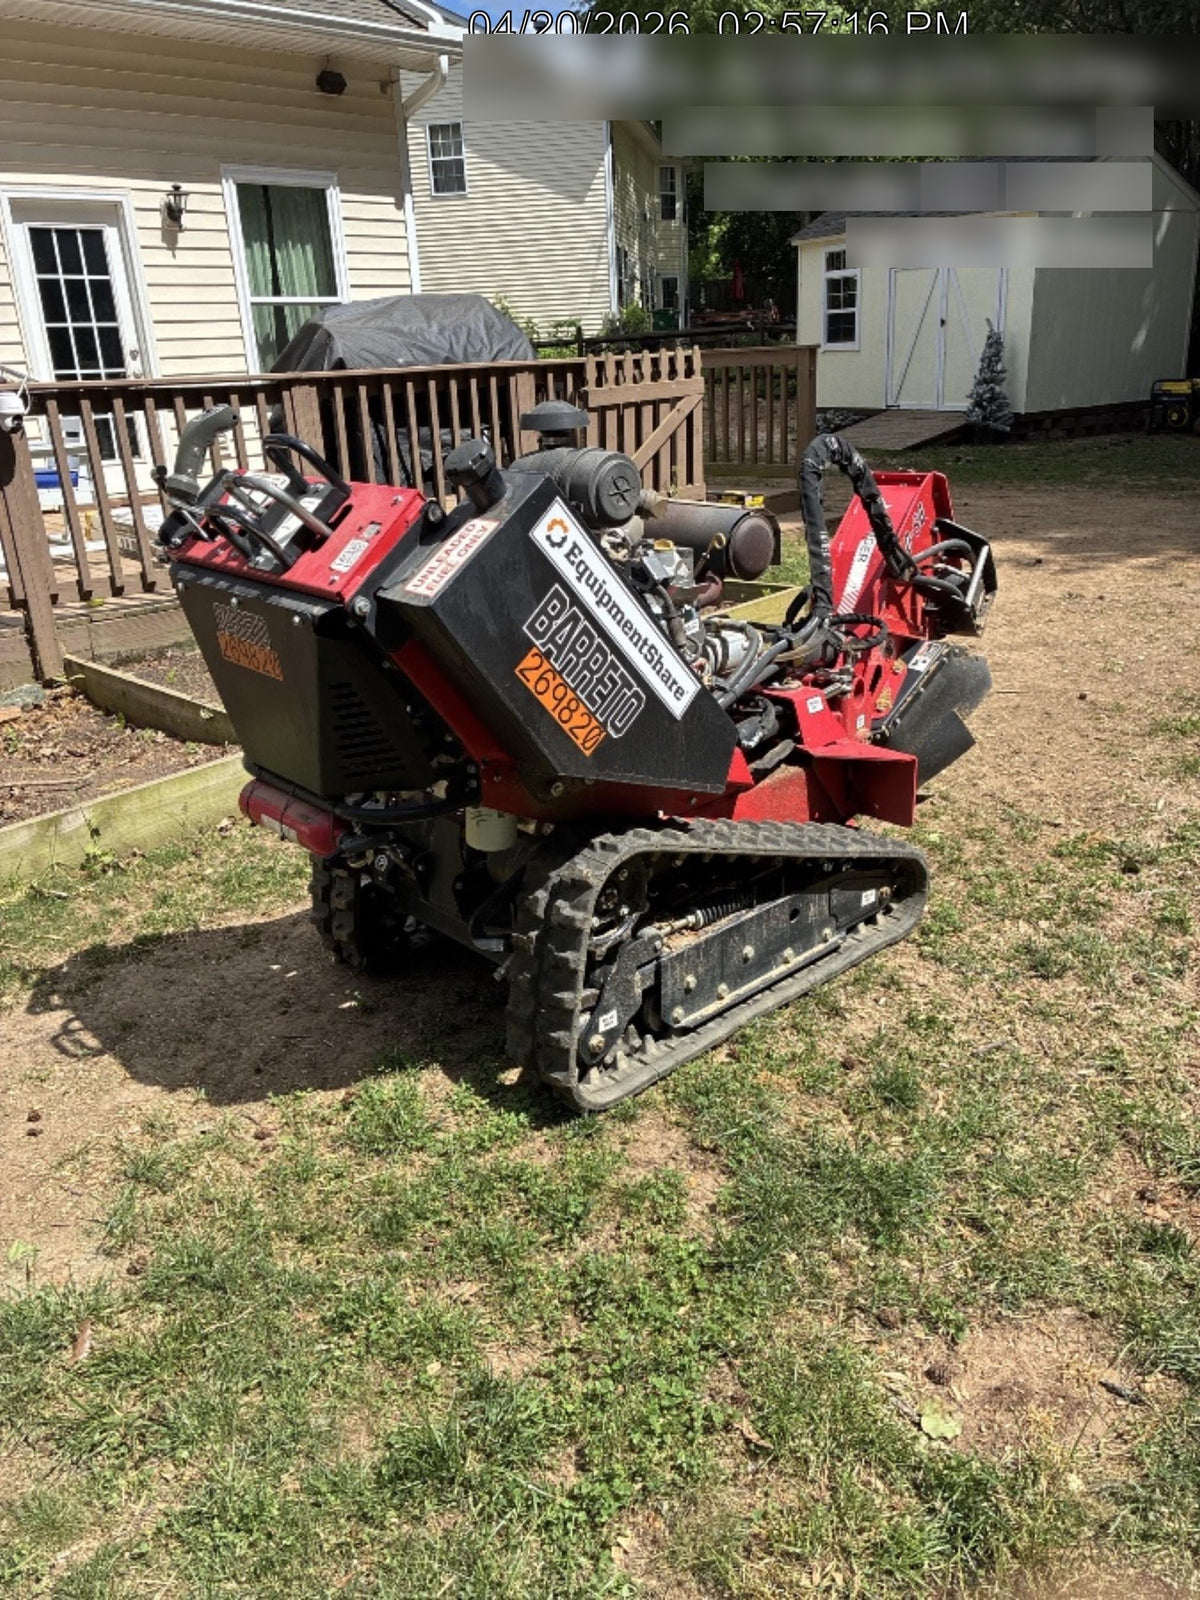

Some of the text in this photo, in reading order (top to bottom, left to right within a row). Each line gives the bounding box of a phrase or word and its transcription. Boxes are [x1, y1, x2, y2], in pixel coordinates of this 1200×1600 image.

[412, 523, 476, 588] UNLEADED
[426, 525, 488, 592] FUEL ONLY
[522, 583, 646, 739] BARRETO
[563, 541, 688, 702] EquipmentShare
[519, 652, 604, 753] 269820
